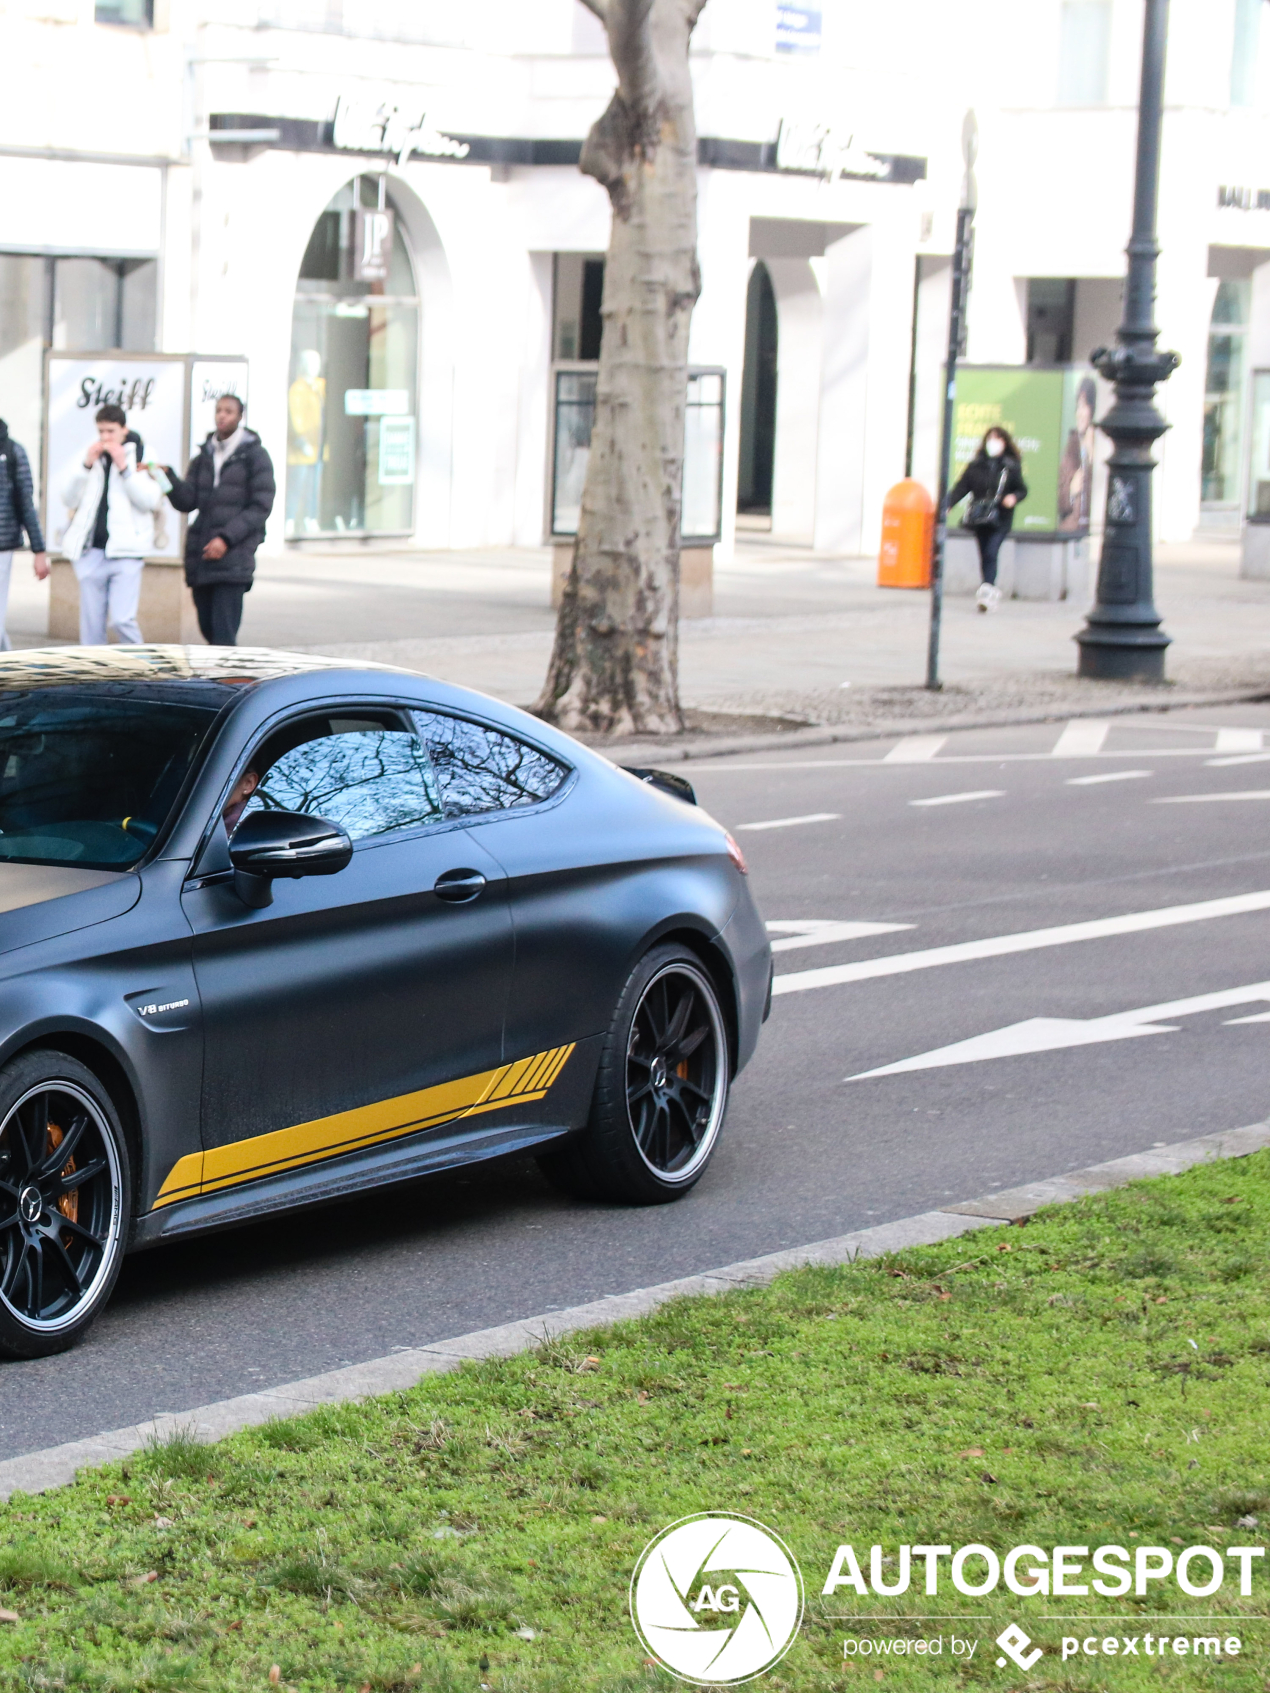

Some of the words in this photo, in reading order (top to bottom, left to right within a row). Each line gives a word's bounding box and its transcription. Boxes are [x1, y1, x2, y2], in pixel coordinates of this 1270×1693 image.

[361, 213, 389, 266] JP
[77, 377, 154, 410] Steiff
[138, 1004, 157, 1016] V8
[158, 999, 189, 1012] BITURBO
